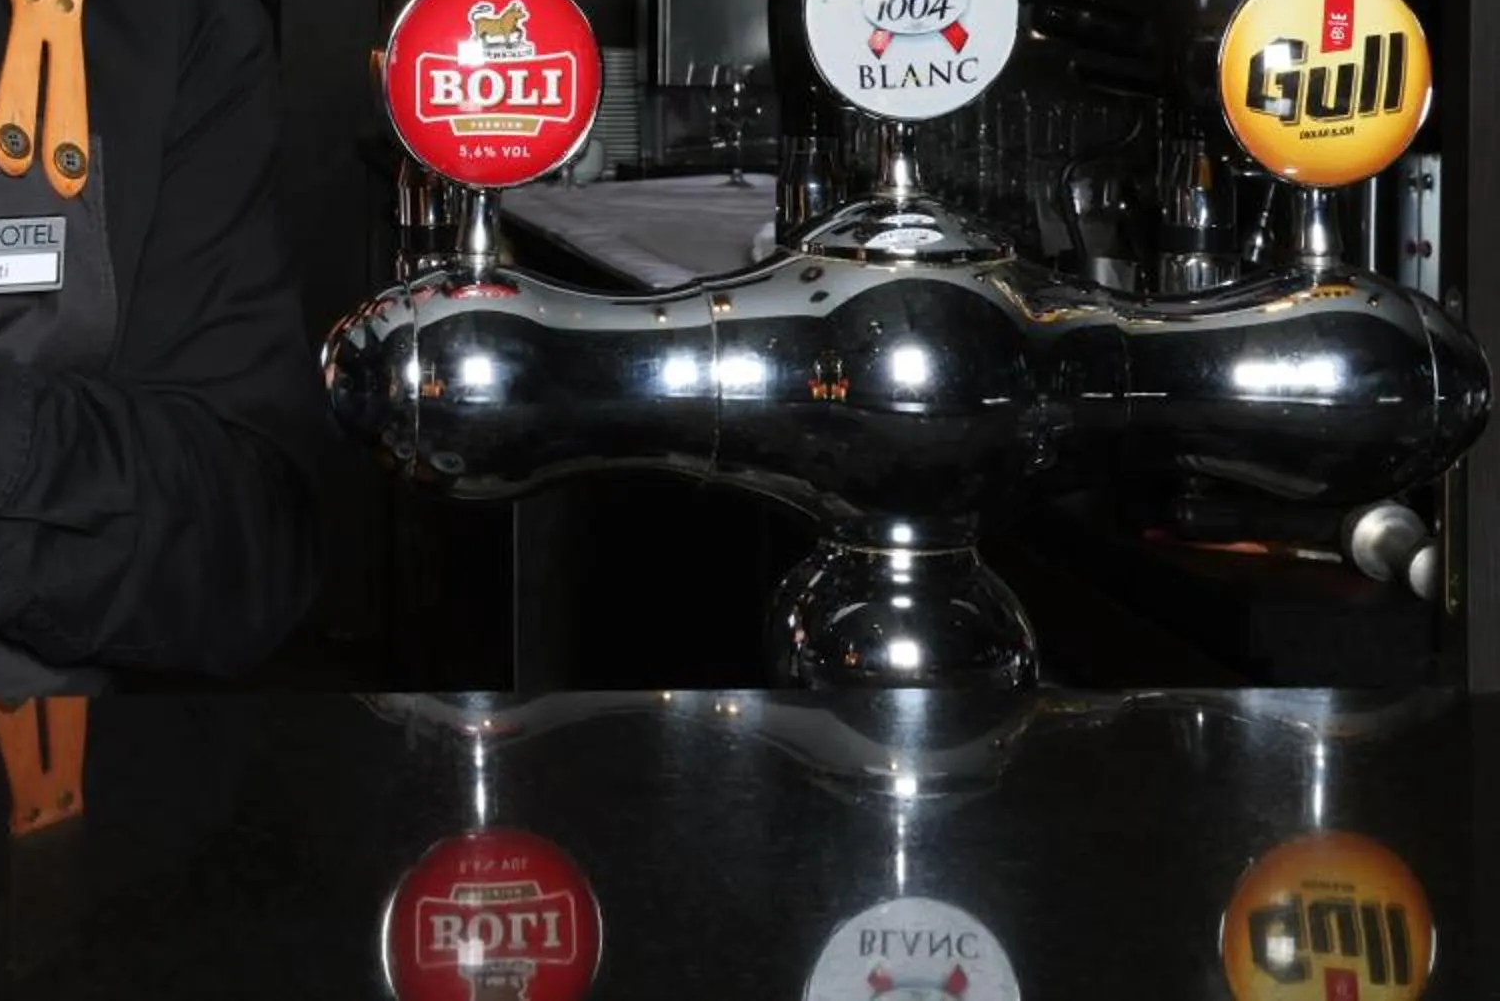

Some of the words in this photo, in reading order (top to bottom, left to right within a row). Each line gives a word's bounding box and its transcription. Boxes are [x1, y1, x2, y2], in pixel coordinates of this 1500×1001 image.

[429, 69, 563, 107] BOLI
[858, 57, 980, 90] BLANC
[1245, 31, 1408, 126] Gull
[501, 144, 531, 158] VOL
